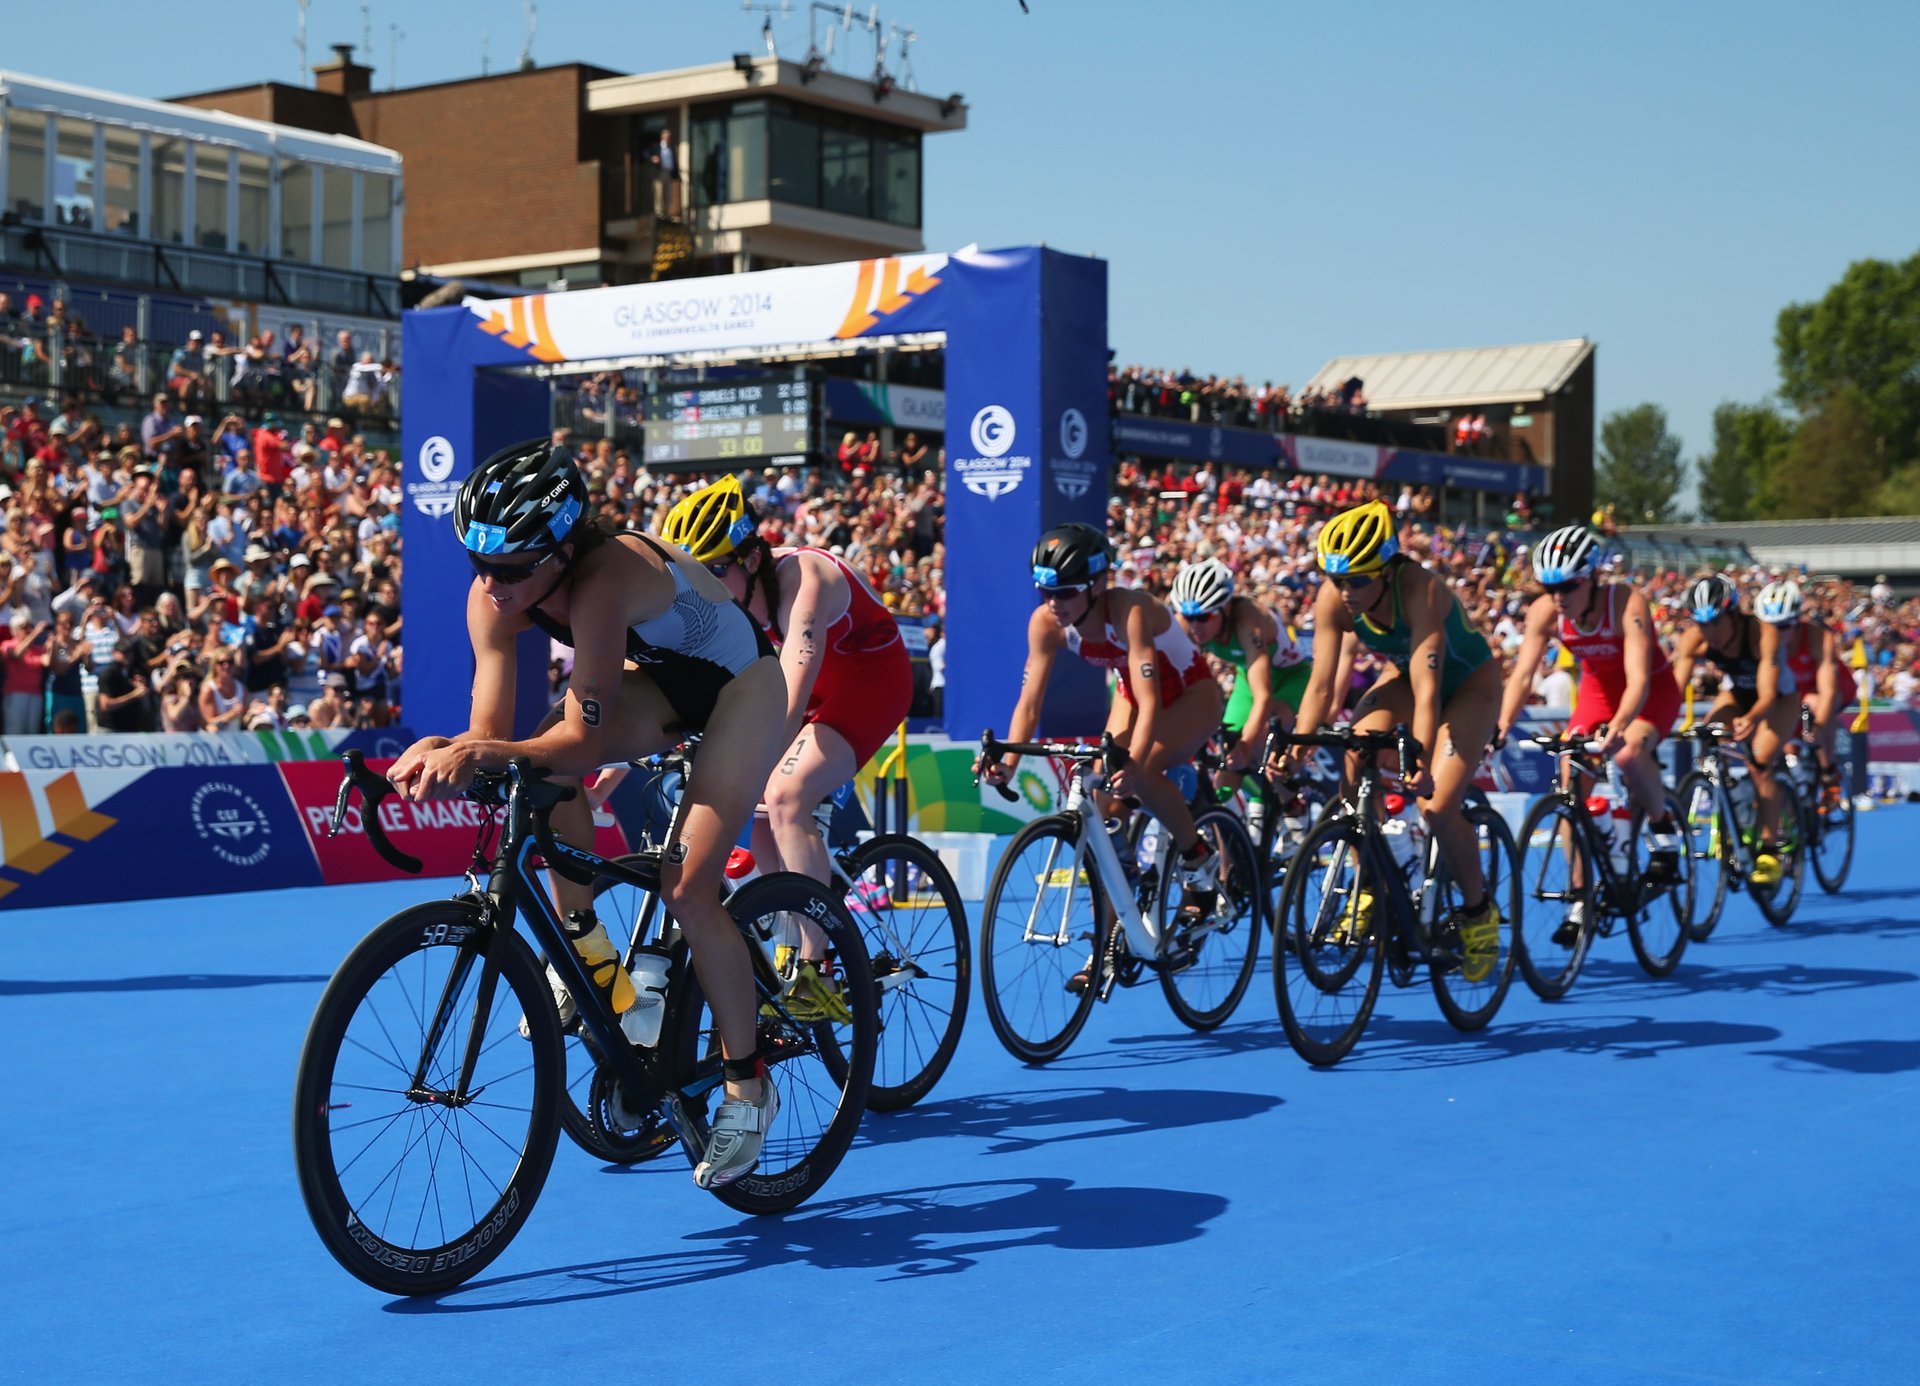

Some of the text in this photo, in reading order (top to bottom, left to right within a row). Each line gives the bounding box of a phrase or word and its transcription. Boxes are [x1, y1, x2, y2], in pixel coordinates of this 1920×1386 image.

[614, 292, 772, 327] GLASGOW 2014
[954, 456, 1031, 472] GLASGOW 2014
[550, 479, 569, 498] GIRO
[478, 531, 486, 551] 9
[1141, 663, 1153, 678] 6
[1427, 653, 1439, 670] 3
[28, 741, 231, 769] GLASGOW 2014
[216, 809, 239, 821] CGF
[306, 801, 410, 836] PEOLE
[213, 842, 271, 866] FEDERATION
[736, 1165, 810, 1197] PROFILE
[350, 1187, 520, 1274] PROFILE DESIGN
